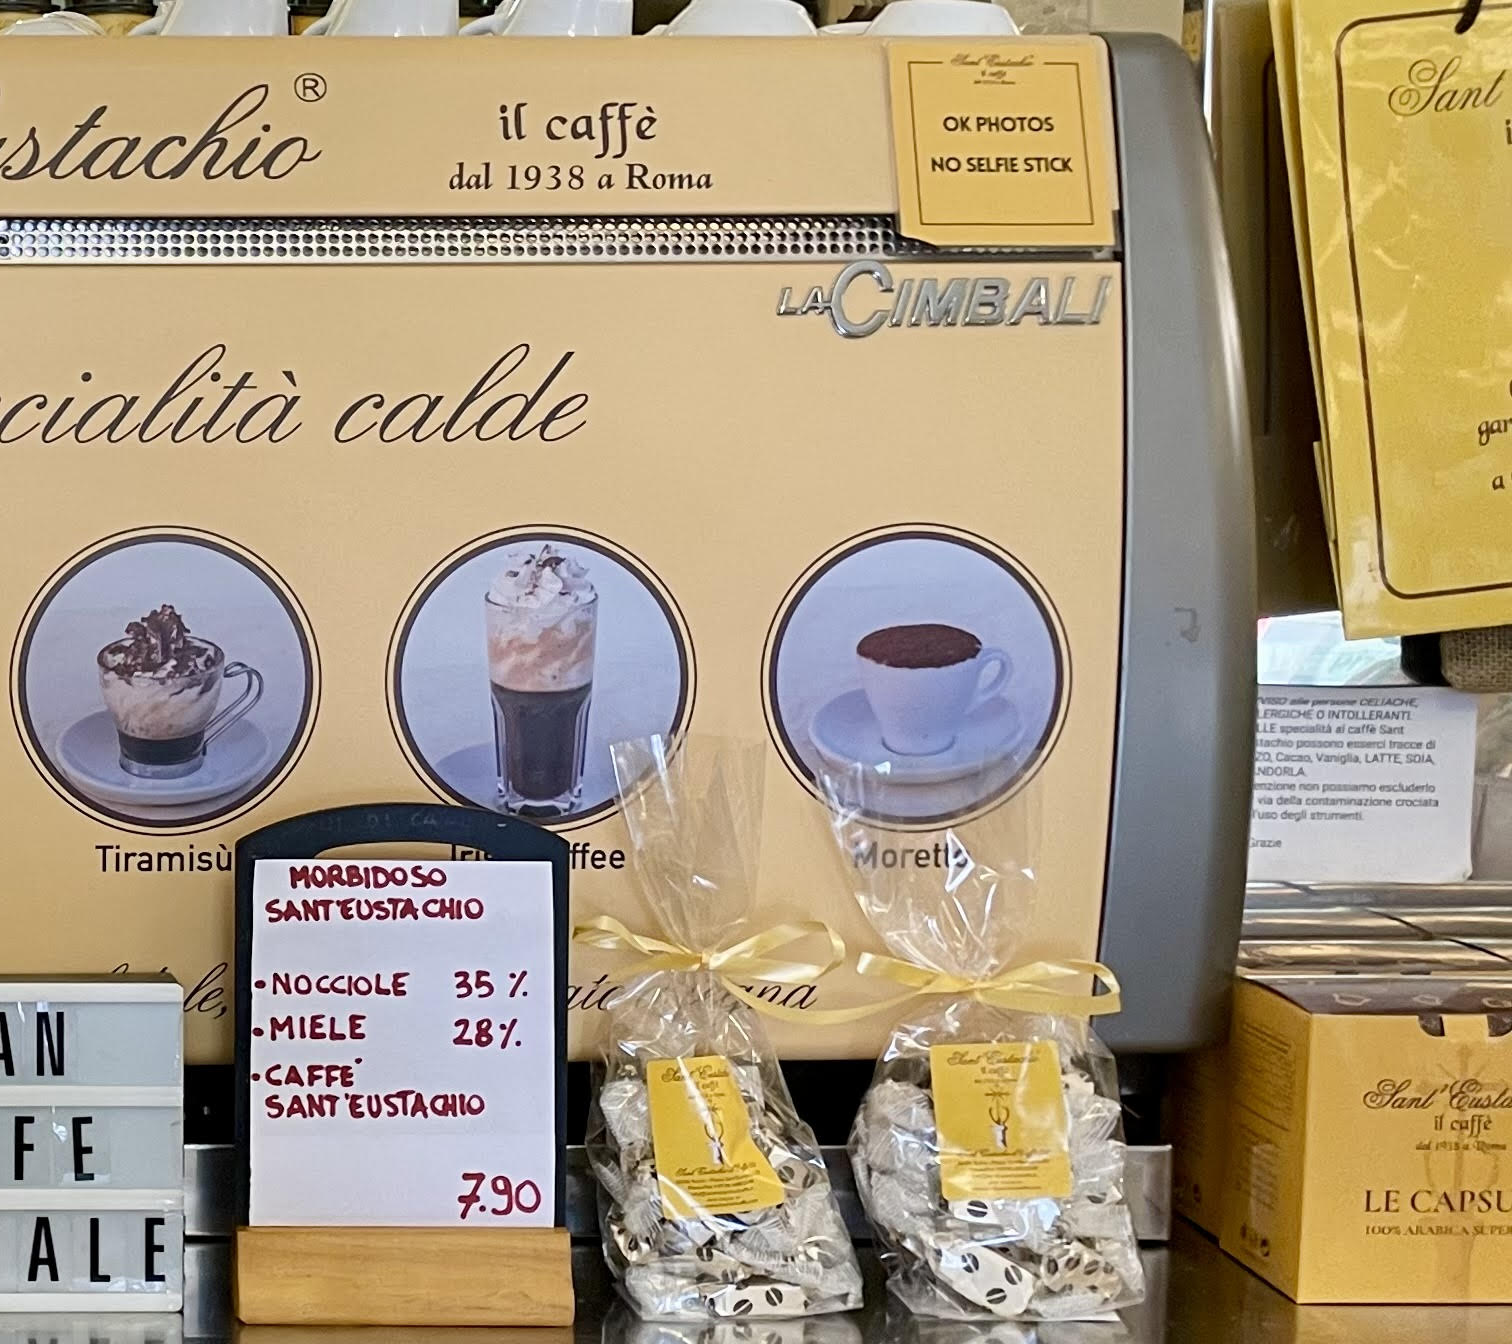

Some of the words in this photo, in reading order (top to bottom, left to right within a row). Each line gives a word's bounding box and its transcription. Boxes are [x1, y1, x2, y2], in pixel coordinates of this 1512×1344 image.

[499, 102, 528, 141] il
[545, 102, 658, 159] caffè
[943, 116, 971, 133] OK
[975, 116, 1055, 133] PHOTOS
[448, 161, 493, 191] dal
[506, 164, 585, 191] 1938
[597, 171, 615, 190] a
[624, 162, 714, 191] Roma
[930, 157, 962, 173] NO
[966, 157, 1019, 173] SELFIE
[1023, 157, 1073, 173] STICK
[828, 259, 1113, 339] CIMBALI
[332, 348, 589, 447] calde
[1491, 475, 1506, 491] a
[1316, 710, 1325, 719] O
[1347, 723, 1377, 735] caffè
[1379, 724, 1404, 735] Sant
[1295, 740, 1345, 751] possono
[1389, 740, 1423, 749] tracce
[1425, 739, 1436, 749] di
[1298, 784, 1320, 792] non
[1321, 783, 1377, 794] possiamo
[1257, 797, 1273, 806] via
[1276, 797, 1303, 806] della
[1305, 797, 1393, 807] contaminazione
[1395, 797, 1440, 808] crociata
[1280, 810, 1307, 822] degli
[94, 844, 234, 873] Tiramisù
[289, 864, 447, 889] MORBIDOSO
[272, 972, 410, 997] NOCCIOLE
[270, 1014, 367, 1041] MIELE
[264, 1089, 486, 1119] SANT'EUSTACHIO
[1434, 1113, 1444, 1131] il
[1450, 1114, 1493, 1138] caffè
[457, 1171, 542, 1219] 7.90
[1365, 1189, 1401, 1213] LE
[1365, 1225, 1401, 1236] 100%
